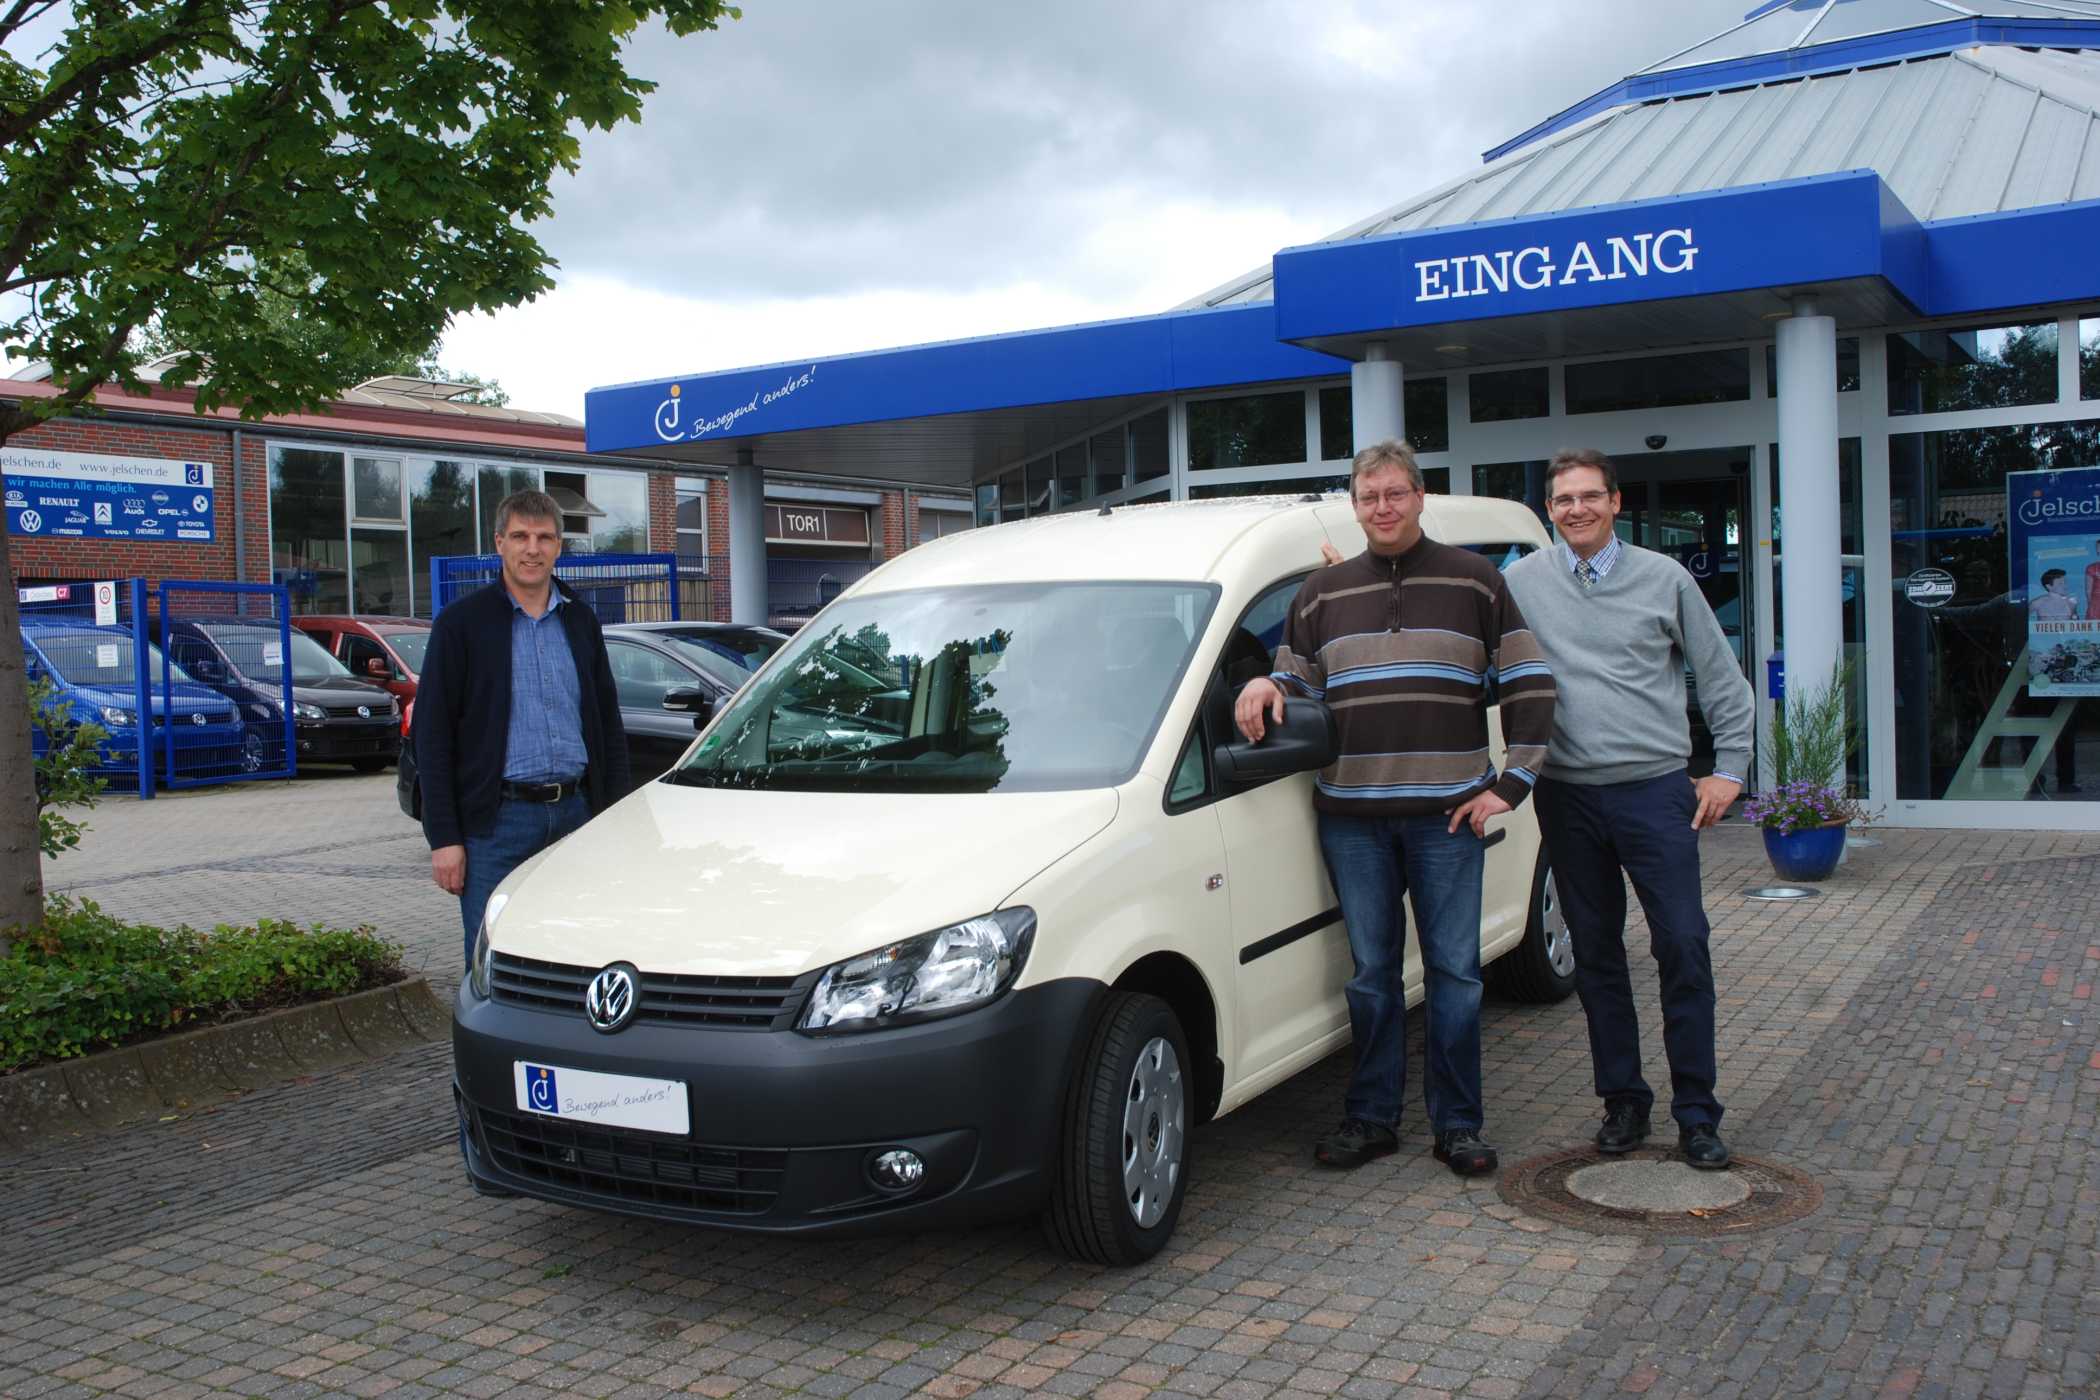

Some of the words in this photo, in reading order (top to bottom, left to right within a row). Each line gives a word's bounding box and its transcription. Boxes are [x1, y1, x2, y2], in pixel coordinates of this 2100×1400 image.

[1414, 228, 1699, 302] EINGANG
[690, 392, 759, 439] Bewegend
[762, 364, 816, 405] anders!
[0, 456, 62, 471] elschen.de
[79, 463, 169, 477] www.jelschen.de
[8, 477, 24, 487] wir
[30, 479, 70, 489] machen
[74, 480, 92, 491] Alle
[96, 482, 137, 494] möglich.
[39, 497, 80, 507] RENAULT
[785, 514, 821, 534] TOR1
[2035, 622, 2066, 633] VIELEN
[2070, 621, 2093, 632] DANK
[562, 1094, 621, 1116] Bewegend
[624, 1084, 672, 1105] anders!
